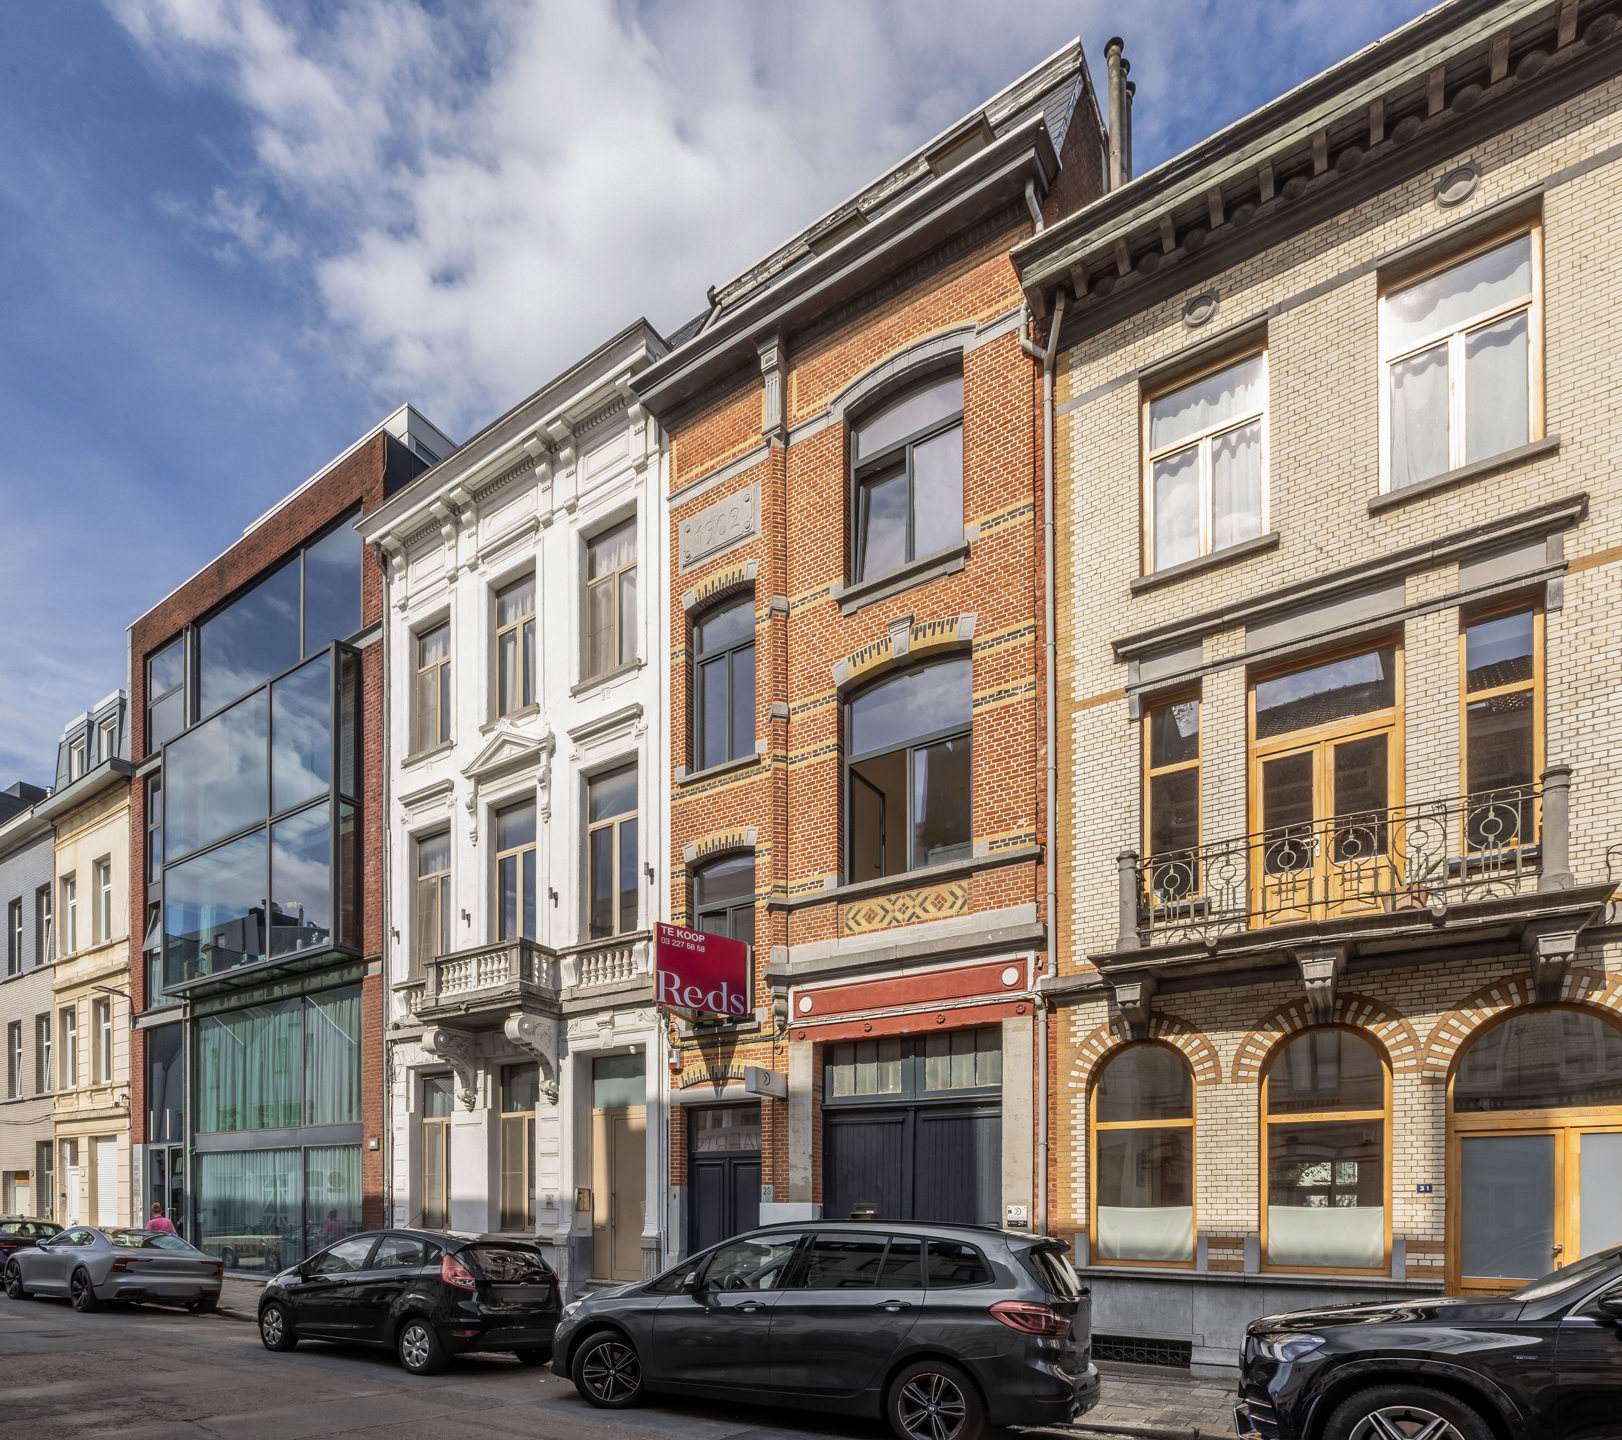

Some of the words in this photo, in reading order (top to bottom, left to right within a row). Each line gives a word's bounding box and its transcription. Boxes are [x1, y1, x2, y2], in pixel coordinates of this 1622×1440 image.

[695, 507, 740, 545] 1902
[661, 925, 674, 937] TE
[676, 929, 705, 943] KOOP
[672, 939, 685, 948] 227
[656, 969, 745, 1015] Reds
